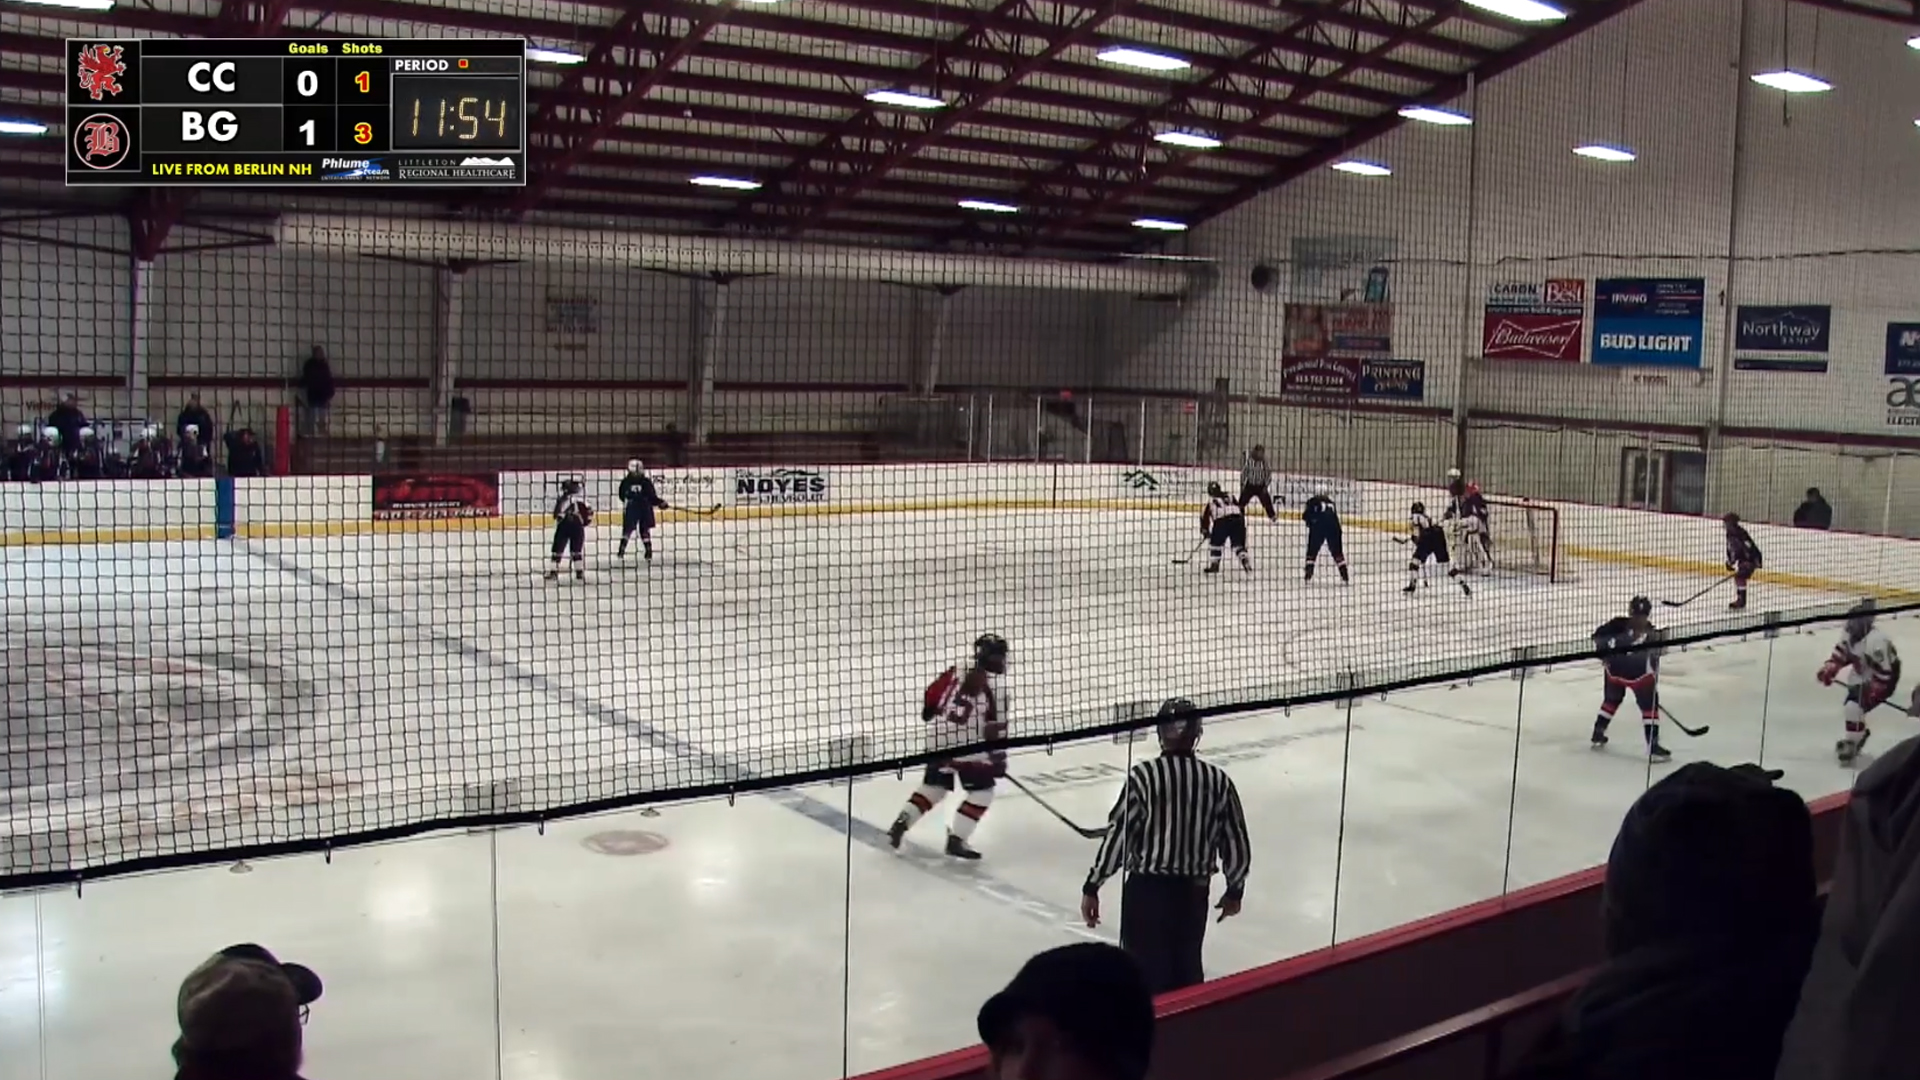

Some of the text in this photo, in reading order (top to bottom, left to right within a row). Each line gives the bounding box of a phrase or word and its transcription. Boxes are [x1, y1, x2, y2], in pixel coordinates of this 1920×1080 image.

[1612, 293, 1648, 305] IRVING
[1494, 327, 1570, 346] Budweiser
[1742, 320, 1821, 341] Northway
[1600, 332, 1692, 353] BUD LIGHT
[737, 477, 825, 494] NOYES
